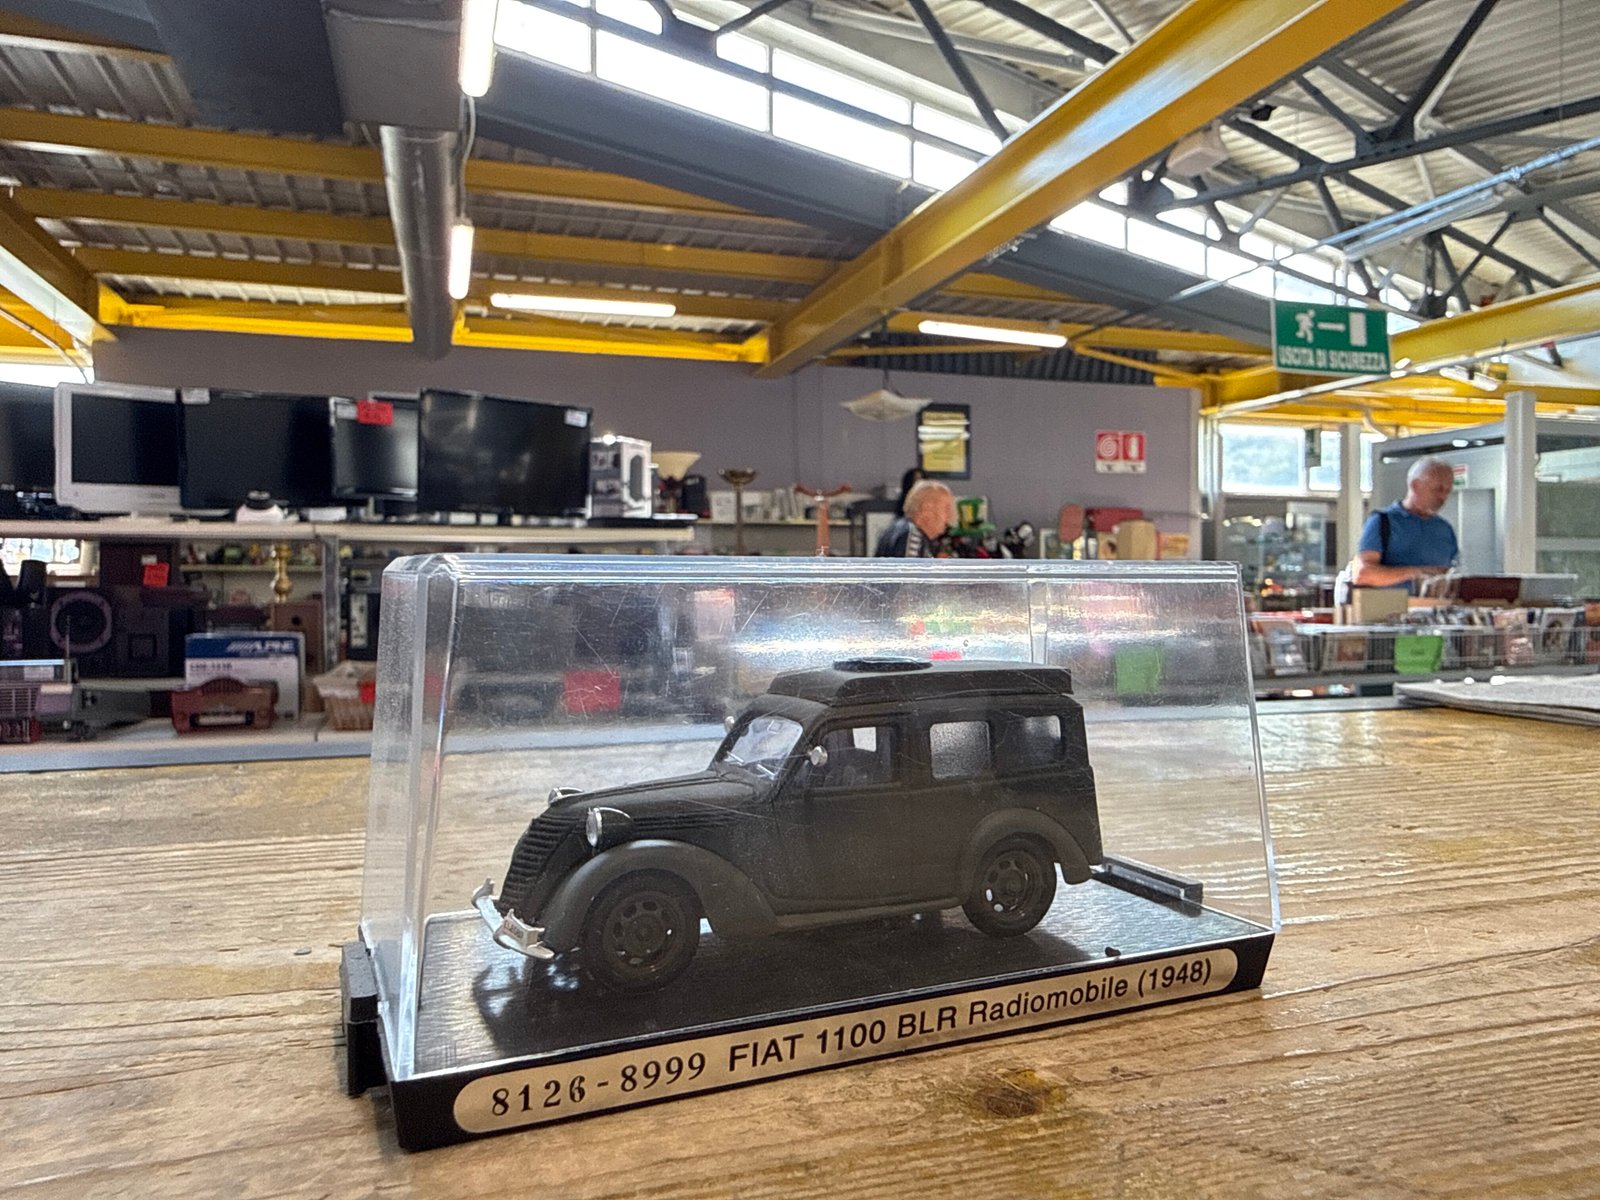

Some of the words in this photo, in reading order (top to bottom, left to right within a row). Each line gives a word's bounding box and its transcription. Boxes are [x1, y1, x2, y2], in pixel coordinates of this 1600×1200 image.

[1279, 346, 1315, 367] USCITA
[1316, 348, 1327, 368] DI
[1329, 350, 1388, 371] SICUREZZA
[729, 1033, 804, 1072] FIAT
[816, 1019, 886, 1054] 1100
[897, 1006, 957, 1039] BLR
[968, 976, 1129, 1025] Radiomobile
[1138, 957, 1212, 998] (1948)
